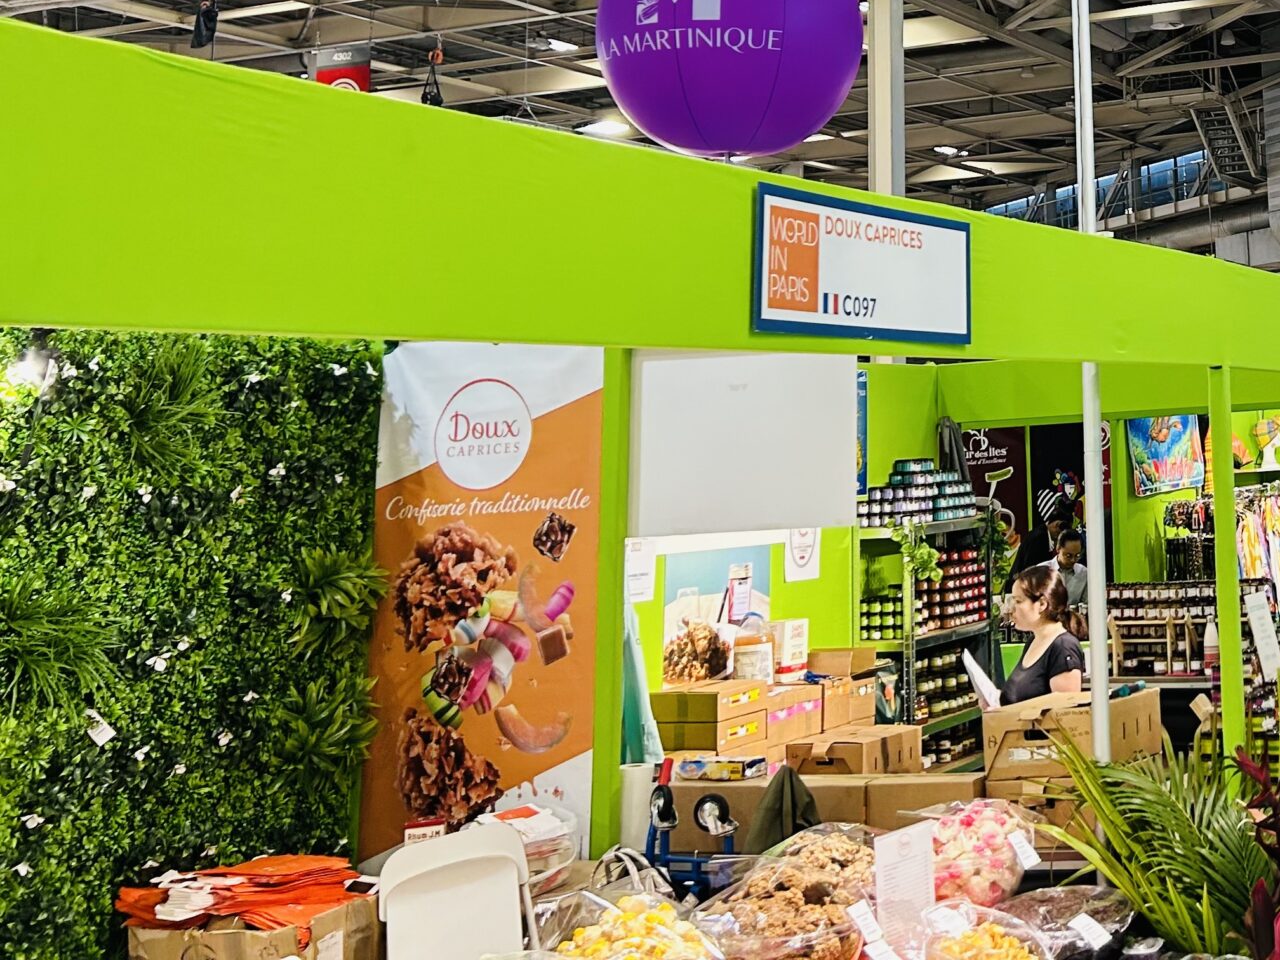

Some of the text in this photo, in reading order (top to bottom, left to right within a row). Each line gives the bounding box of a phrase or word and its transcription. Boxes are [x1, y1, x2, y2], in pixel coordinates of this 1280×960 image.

[600, 27, 783, 60] LA MARTINIQUE
[771, 215, 818, 247] WORLD
[825, 215, 924, 250] DOUX CAPRICES
[770, 245, 788, 271] IN
[769, 274, 810, 303] PARIS
[842, 294, 877, 318] C097
[448, 410, 520, 443] Doux
[446, 442, 521, 458] CAPRICES
[386, 488, 590, 526] Confiserie traditionnelle
